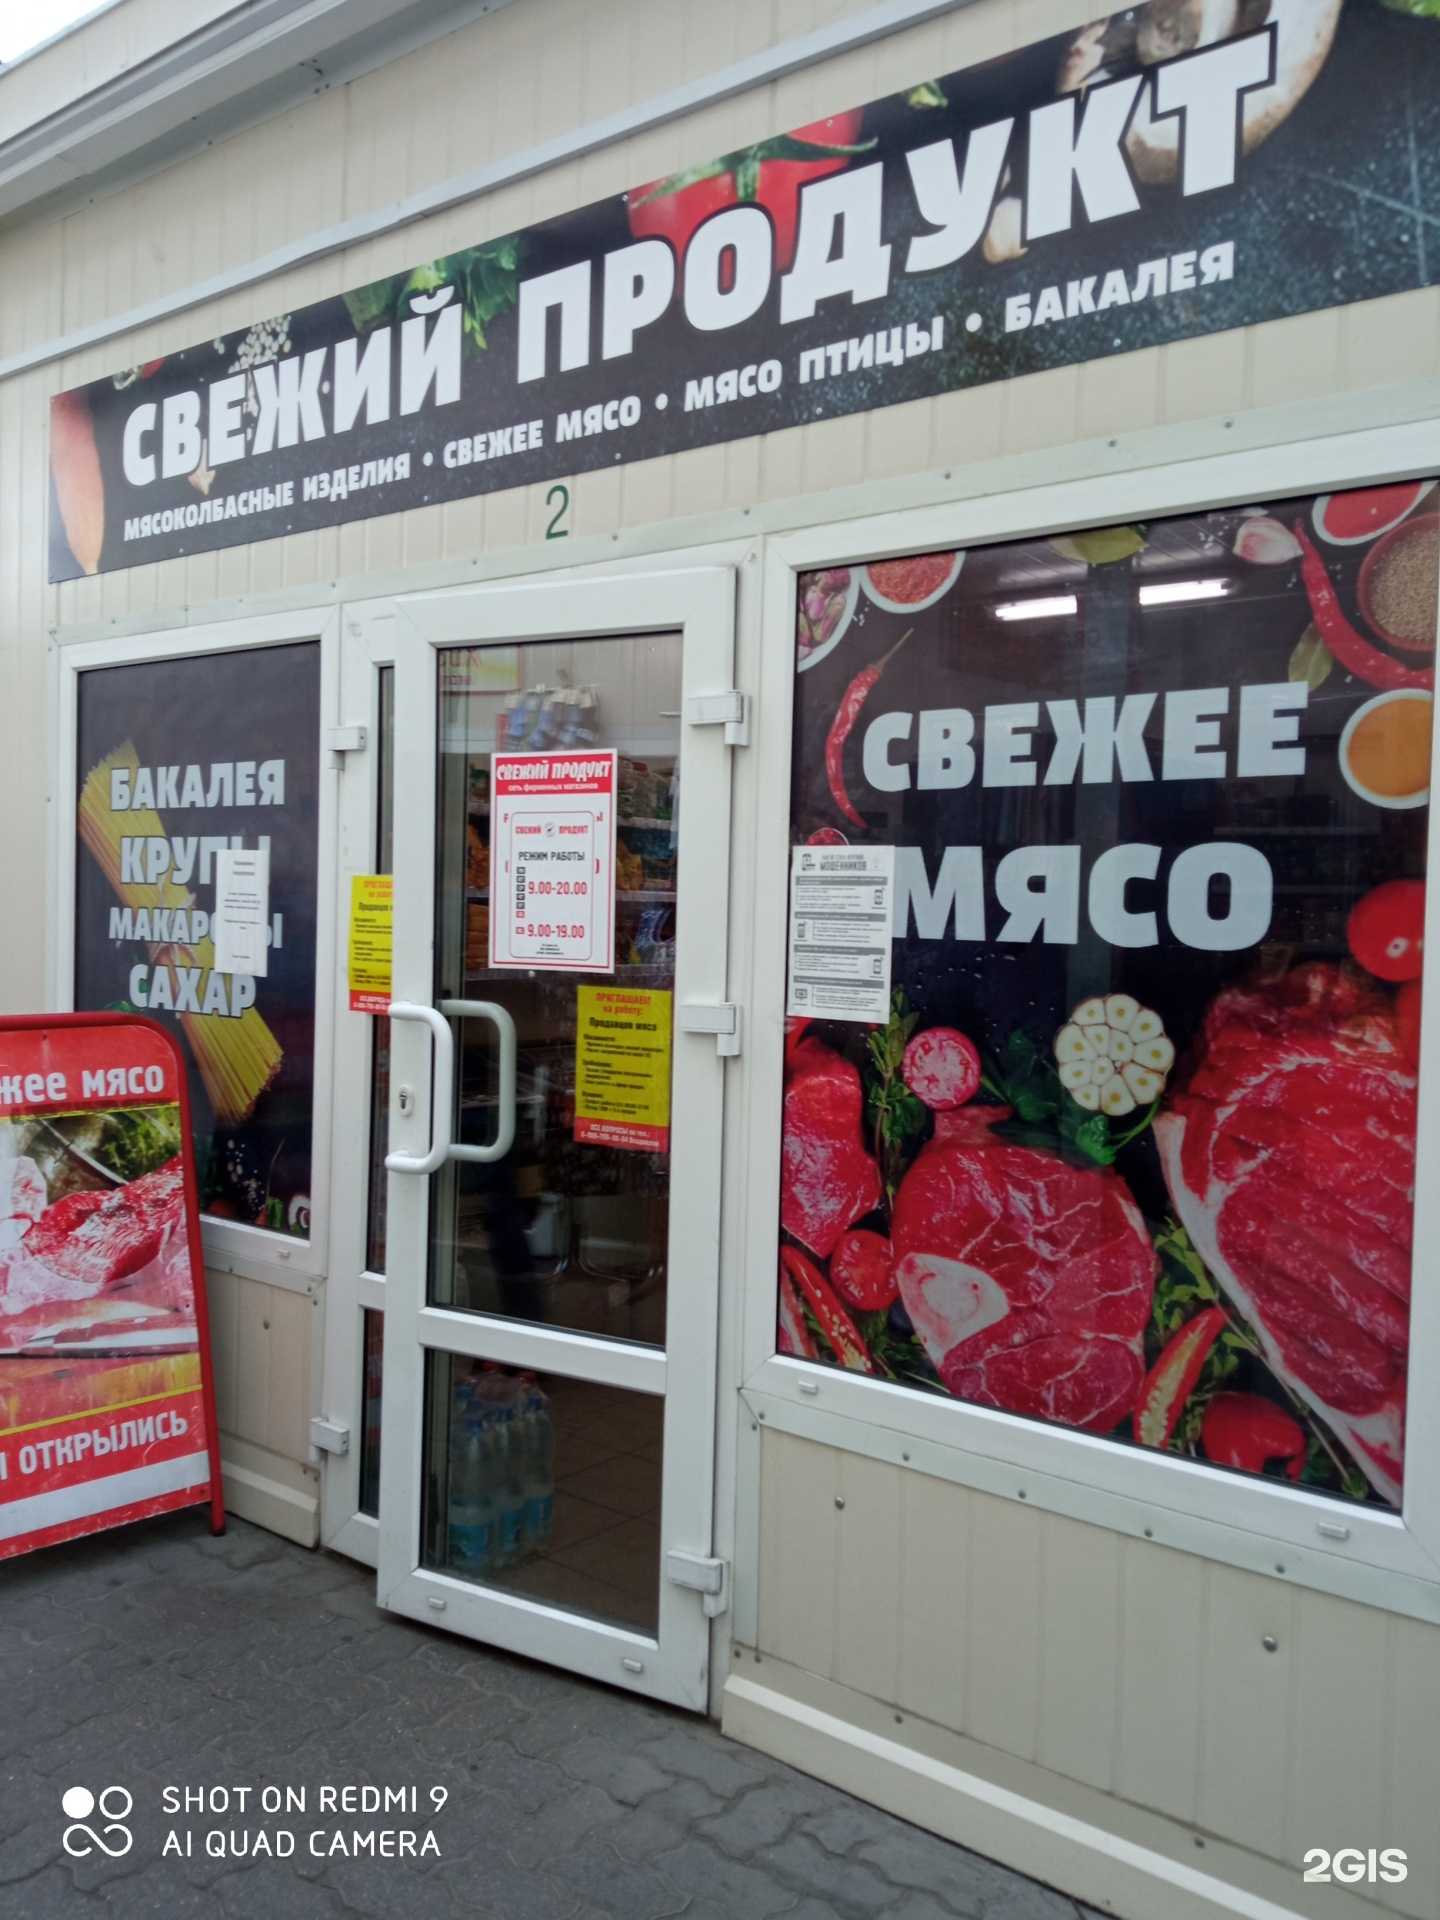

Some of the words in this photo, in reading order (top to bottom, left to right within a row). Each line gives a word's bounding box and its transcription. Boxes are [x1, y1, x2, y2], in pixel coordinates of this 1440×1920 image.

[122, 286, 462, 486] СВЕЖИЙ
[518, 30, 1271, 384] ПРОДУКТ
[123, 488, 294, 542] МЯСОКОЛБАСНЫЕ
[303, 453, 410, 502] ИЗДЕЛИЯ
[442, 419, 543, 469] СВЕЖЕЕ
[556, 395, 641, 443] МЯСО
[684, 359, 783, 413] МЯСО
[799, 316, 944, 384] ПТИЦЫ
[1005, 241, 1235, 333] БАКАЛЕЯ
[545, 485, 570, 540] 2
[862, 681, 1309, 792] СВЕЖЕЕ
[111, 759, 285, 811] БАКАЛЕЯ
[551, 760, 611, 782] ПРОДУКТ
[518, 851, 547, 861] РЕЖИМ
[551, 851, 585, 861] РАБОТЫ
[528, 881, 587, 895] 9.00-20.00
[893, 841, 1274, 951] МЯСО
[527, 924, 585, 938] 9.00-19.00
[129, 963, 256, 1018] САХАР
[19, 1411, 188, 1474] ОТКРЫЛИСЬ
